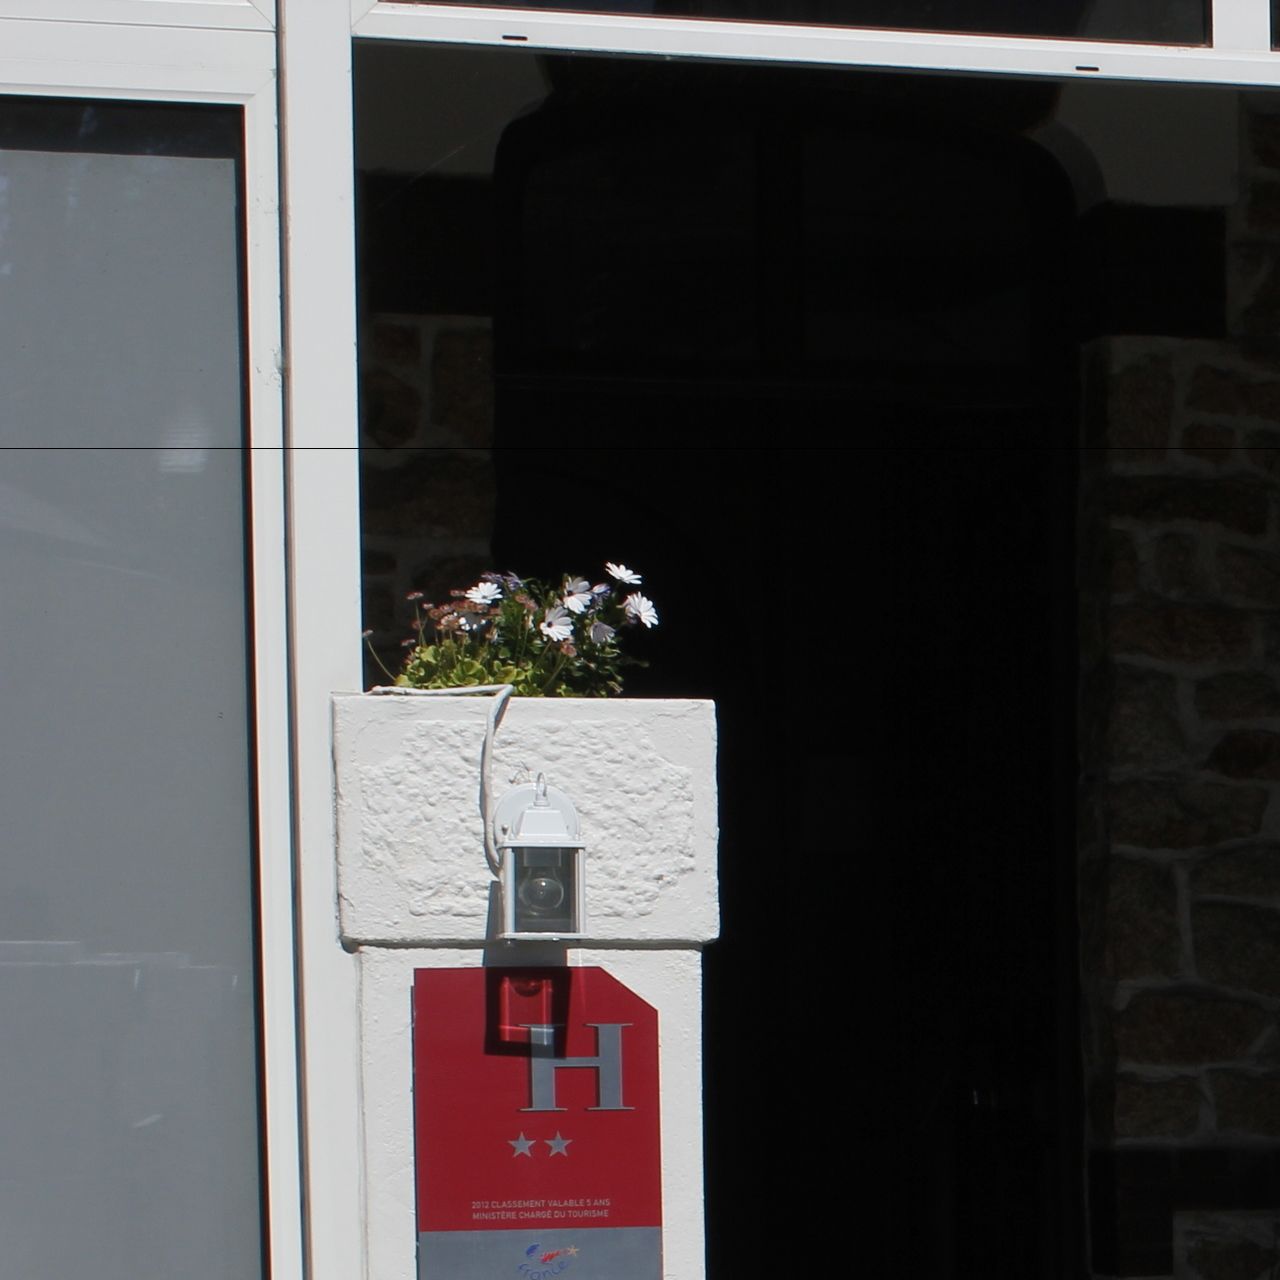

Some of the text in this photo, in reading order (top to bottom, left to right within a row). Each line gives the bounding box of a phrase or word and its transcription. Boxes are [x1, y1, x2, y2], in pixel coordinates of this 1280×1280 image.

[517, 1022, 635, 1112] H
[491, 1199, 546, 1208] CLASSEMENT
[548, 1198, 584, 1207] VALABLE
[586, 1198, 591, 1206] 5
[593, 1198, 611, 1206] ANS
[472, 1208, 517, 1219] MINISTÈRE
[554, 1209, 566, 1218] DU
[567, 1209, 609, 1217] TOURISME
